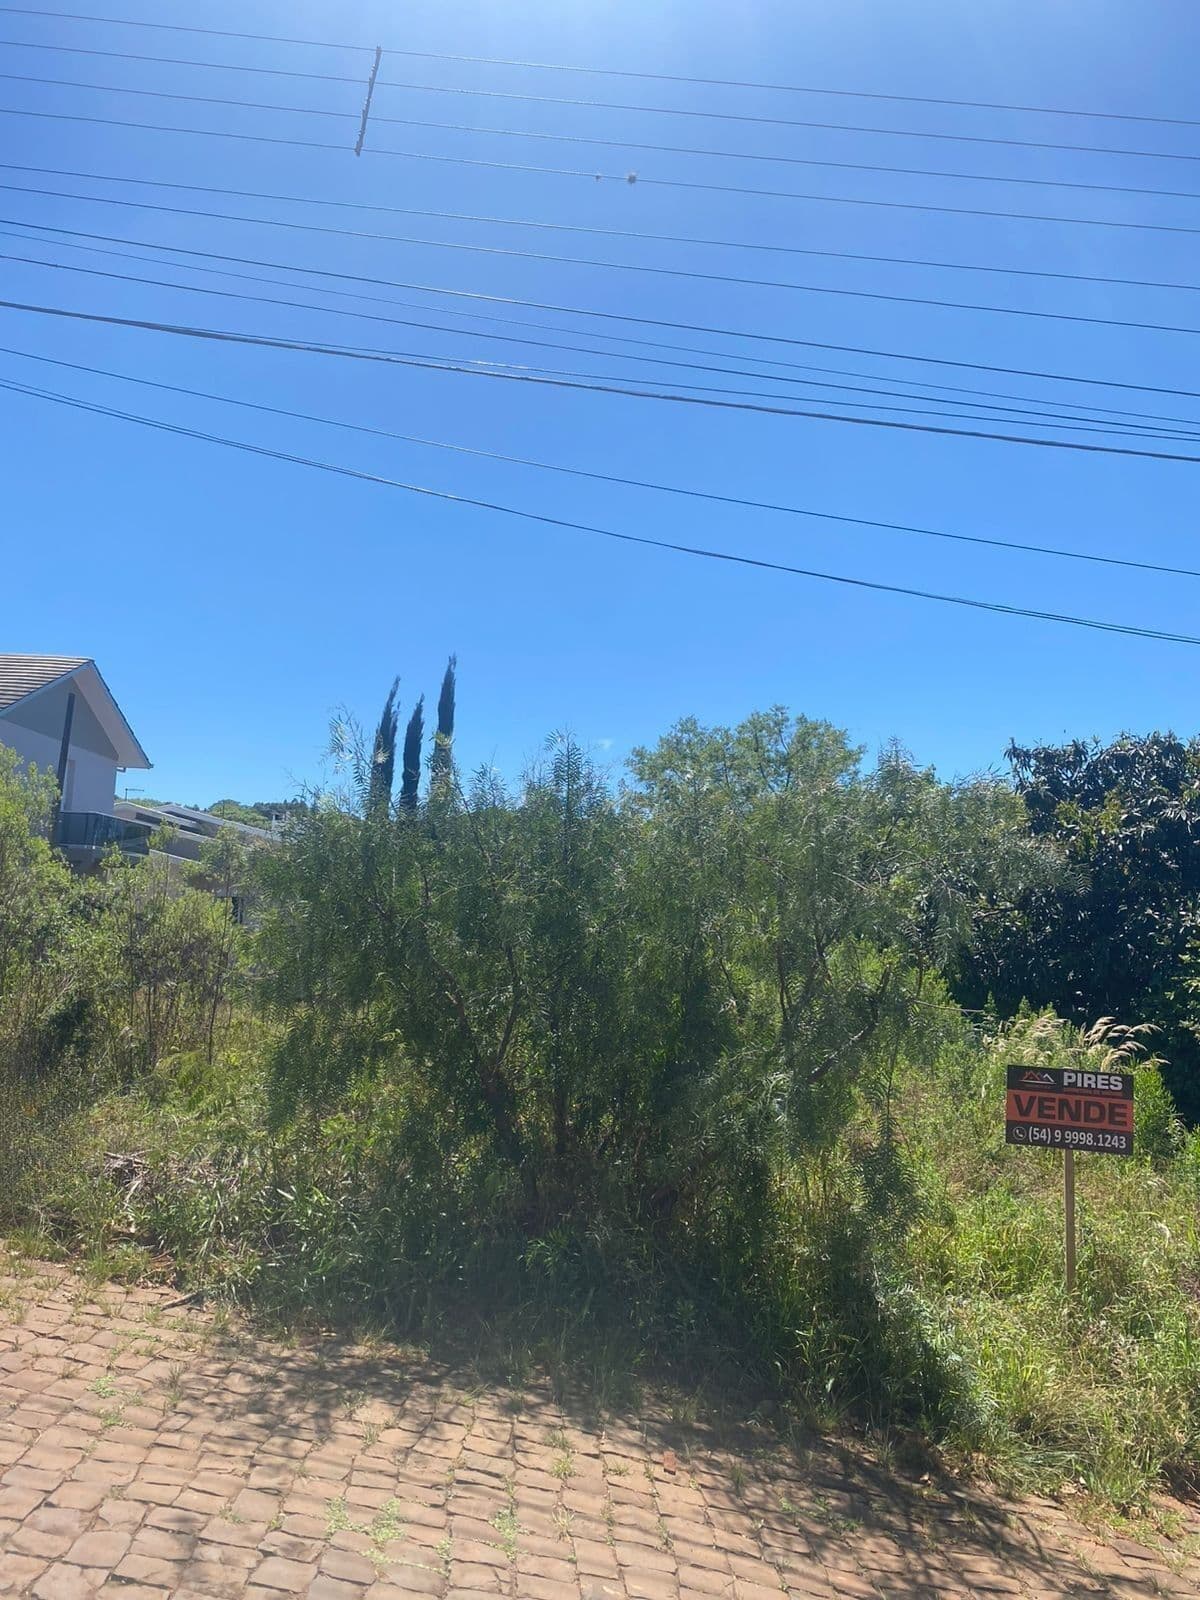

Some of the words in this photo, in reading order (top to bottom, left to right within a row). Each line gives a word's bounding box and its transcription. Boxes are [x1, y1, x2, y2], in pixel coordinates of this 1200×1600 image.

[1063, 1072, 1123, 1091] PIRES
[1014, 1094, 1128, 1126] VENDE
[1028, 1126, 1051, 1144] (54)
[1054, 1129, 1062, 1143] 9
[1064, 1131, 1126, 1149] 9998.1243
